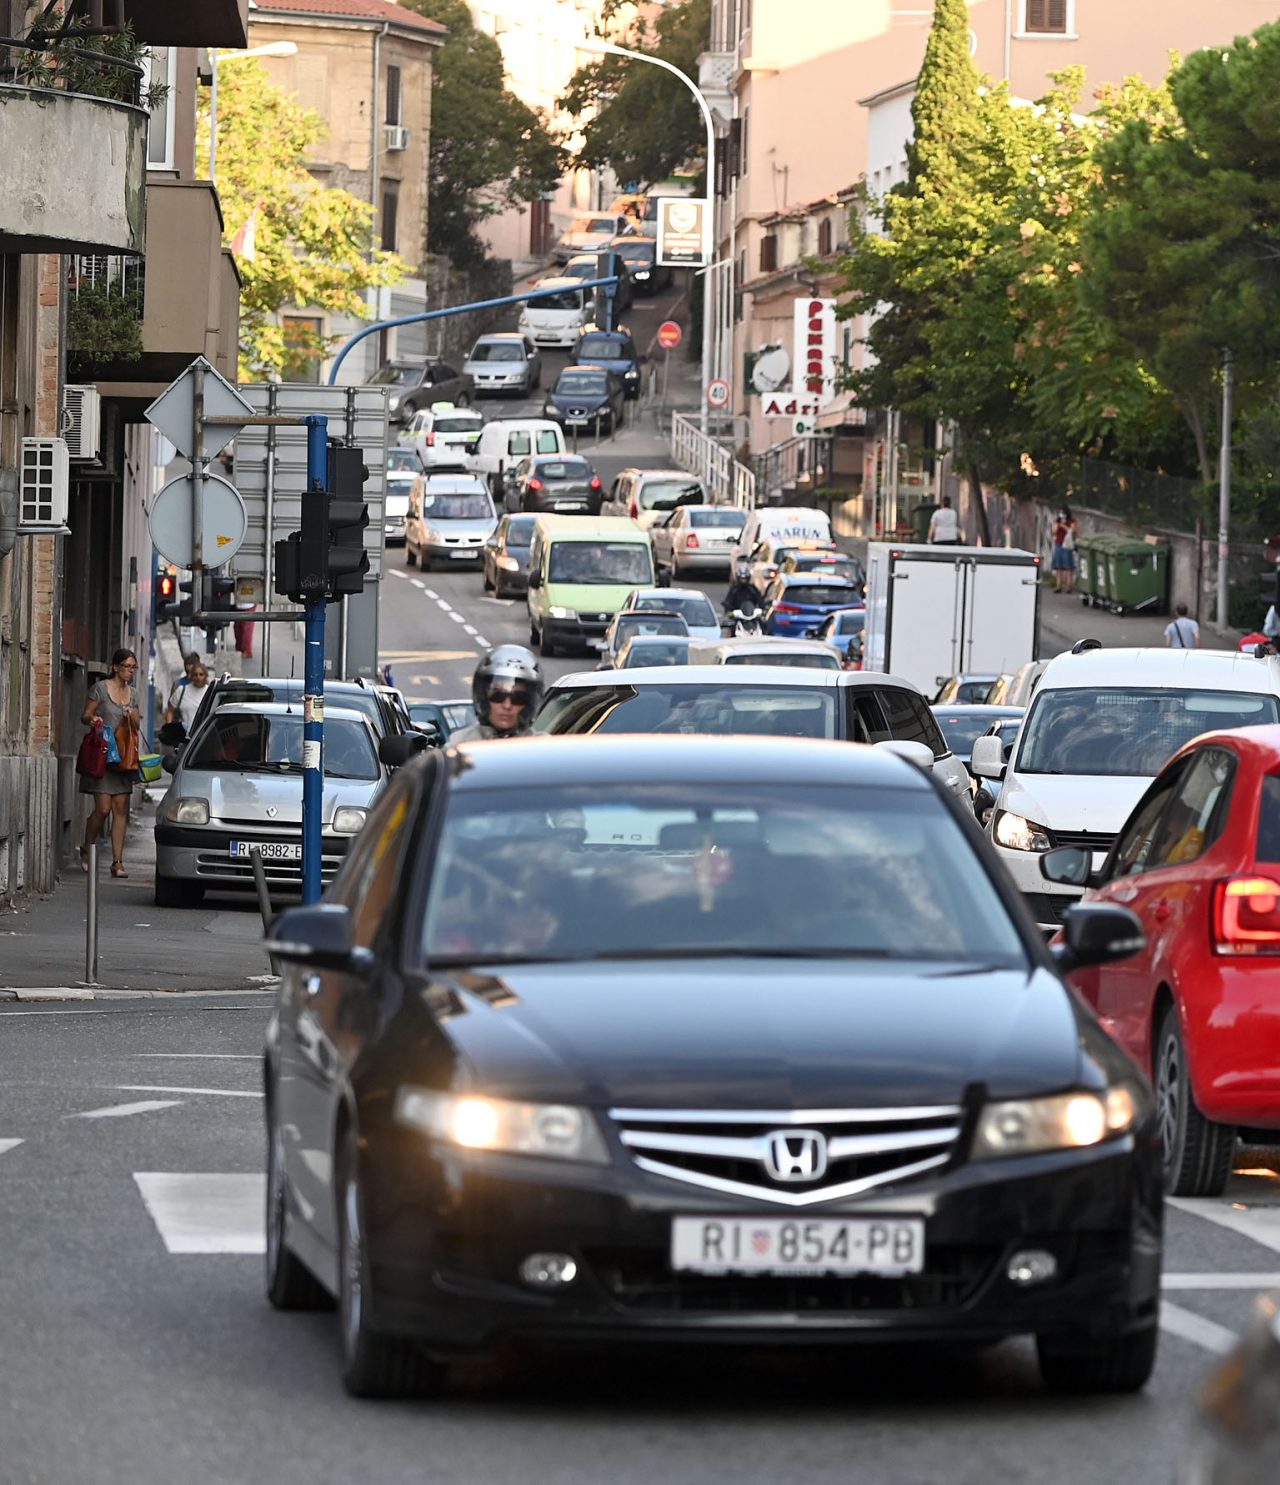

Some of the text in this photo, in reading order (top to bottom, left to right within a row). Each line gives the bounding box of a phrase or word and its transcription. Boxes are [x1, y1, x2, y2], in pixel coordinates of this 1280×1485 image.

[712, 386, 725, 400] 40
[765, 399, 821, 415] Adri
[261, 844, 302, 857] 8982-E
[703, 1222, 914, 1263] RI 854-PB
